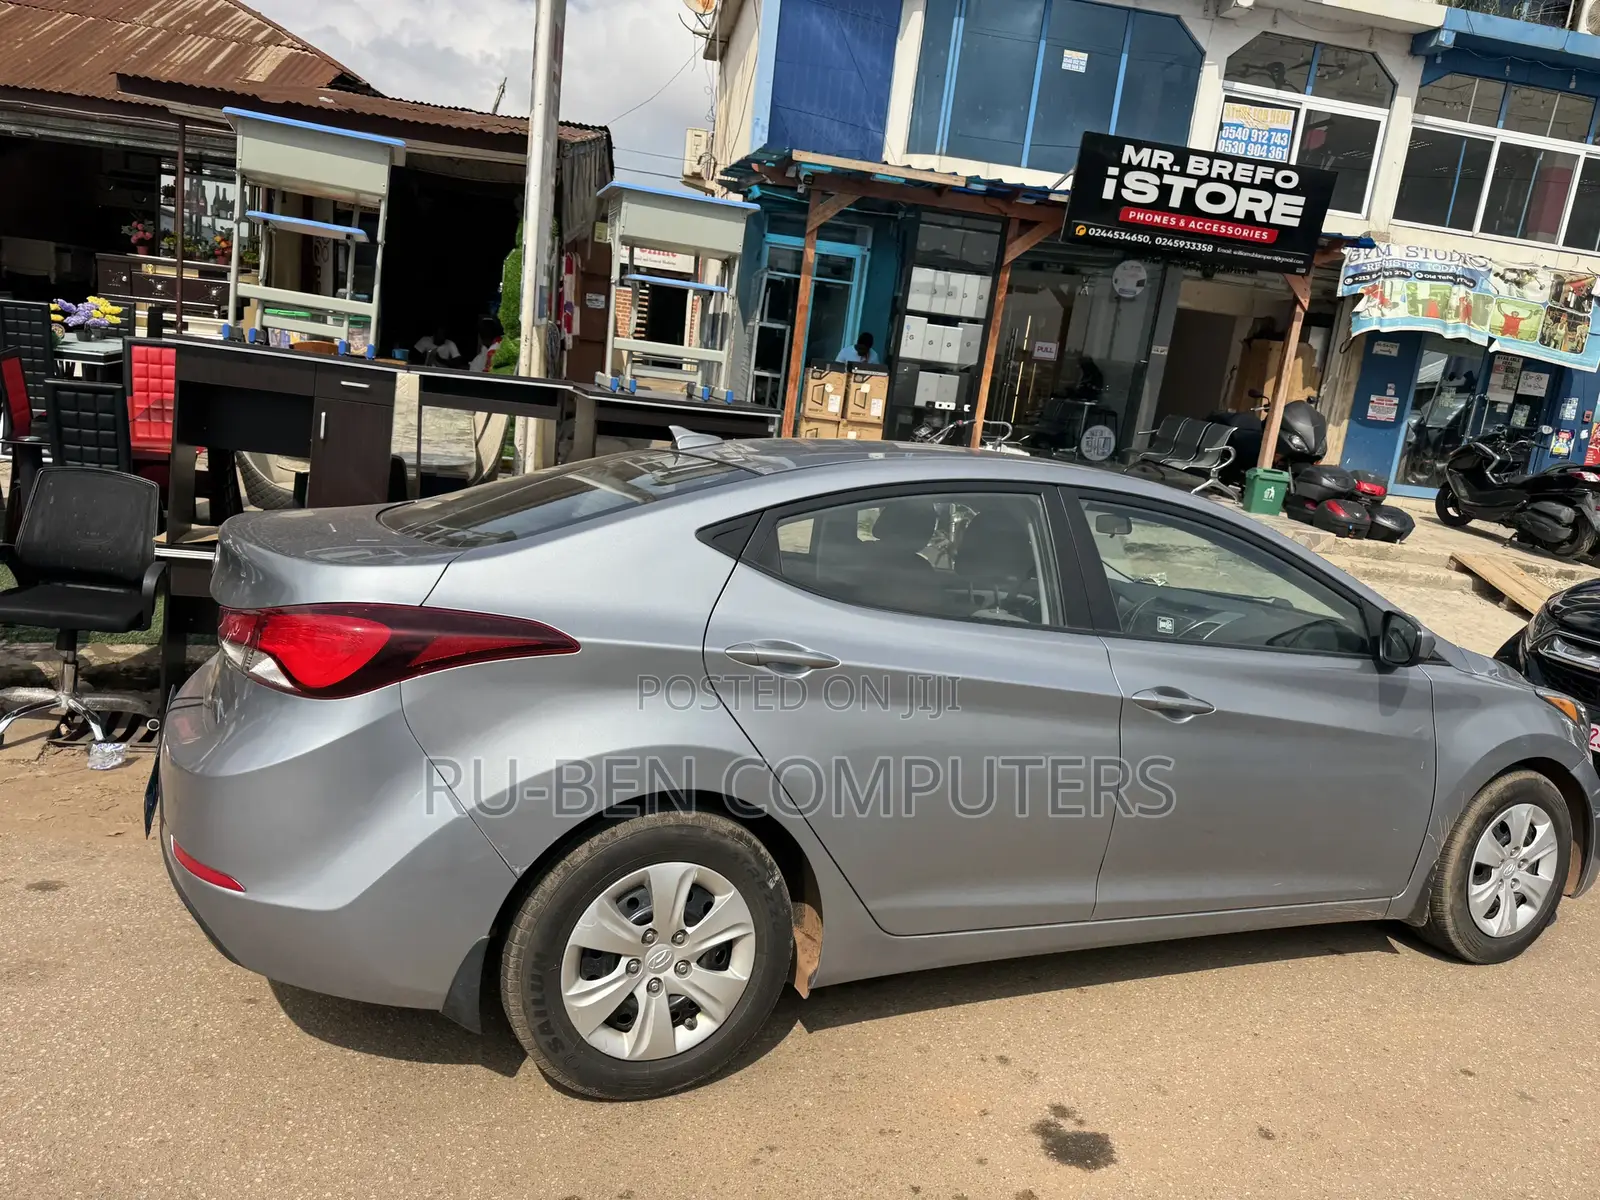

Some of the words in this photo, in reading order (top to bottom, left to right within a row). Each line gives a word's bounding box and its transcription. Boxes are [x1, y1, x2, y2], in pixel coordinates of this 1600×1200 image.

[1222, 126, 1249, 141] 0540
[1250, 129, 1269, 143] 912
[1270, 131, 1288, 146] 743
[1218, 139, 1246, 155] 0530
[1246, 143, 1267, 158] 904
[1268, 146, 1288, 160] 361
[1121, 144, 1180, 173] MR.
[1185, 155, 1300, 189] BREFO
[1101, 166, 1306, 228] iSTORE
[1128, 210, 1176, 226] PHONES
[1178, 219, 1186, 227] &
[1188, 220, 1269, 240] ACCESSORIES
[1088, 227, 1152, 245] 0244534650,
[1155, 237, 1214, 253] 0245933358
[1036, 345, 1054, 354] PULL
